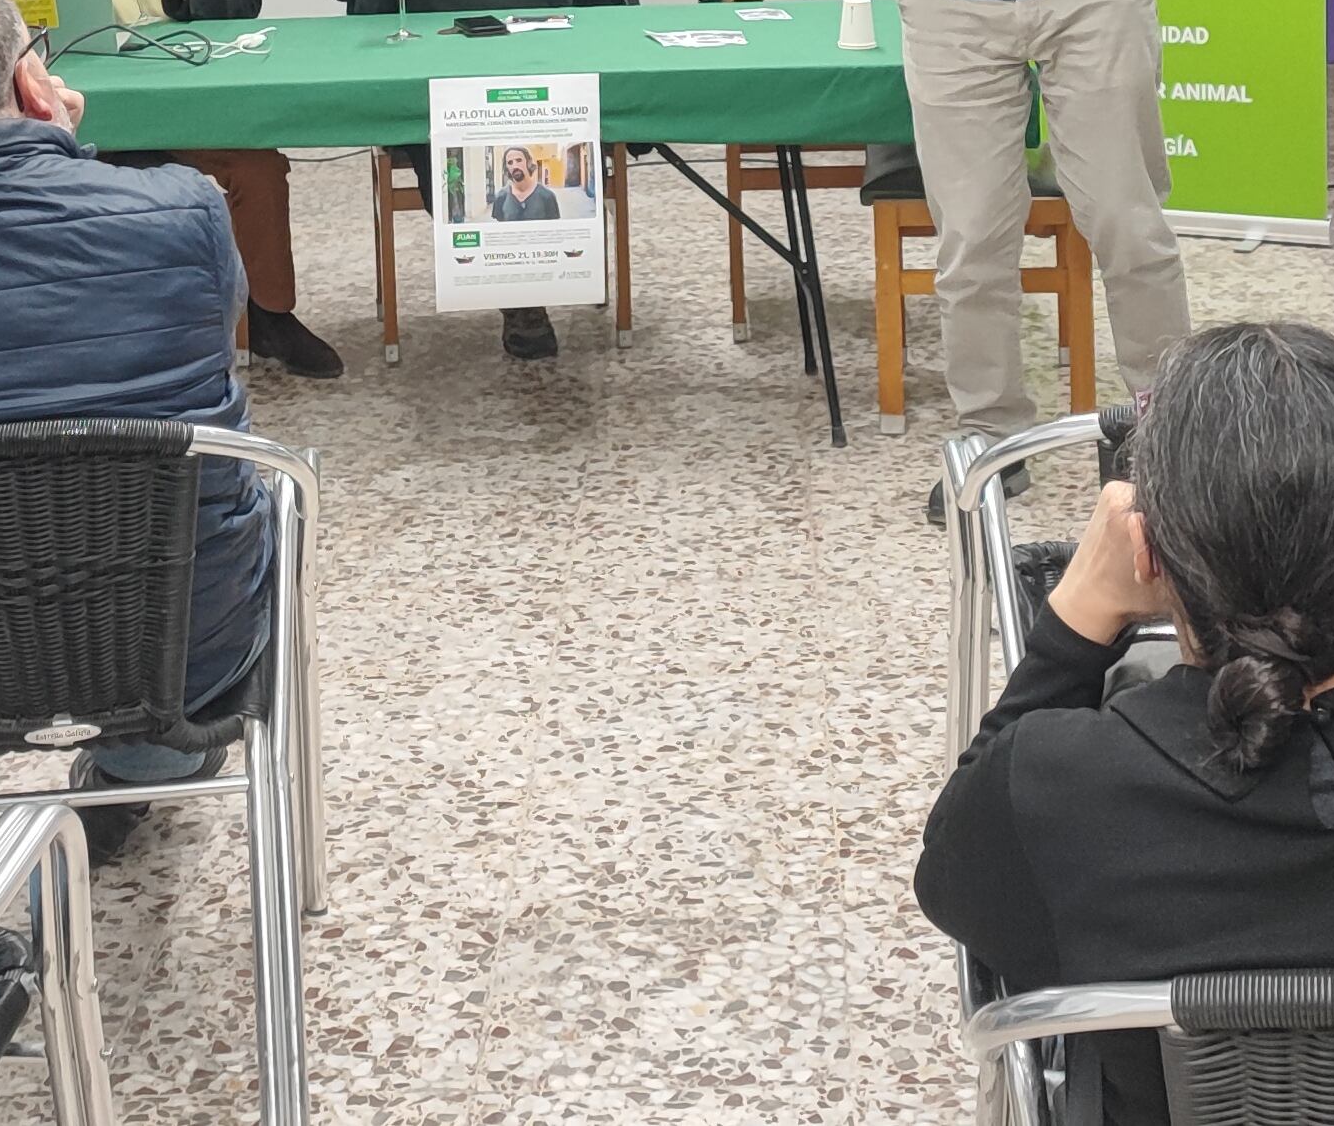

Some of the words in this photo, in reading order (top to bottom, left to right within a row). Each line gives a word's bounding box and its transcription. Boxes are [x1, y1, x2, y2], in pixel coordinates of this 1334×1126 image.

[1161, 25, 1210, 45] IDAD
[1171, 81, 1254, 104] ANIMAL
[459, 108, 507, 120] FLOTILLA
[508, 106, 548, 118] GLOBAL
[550, 105, 590, 116] SUMUD
[1163, 134, 1199, 157] GÍA
